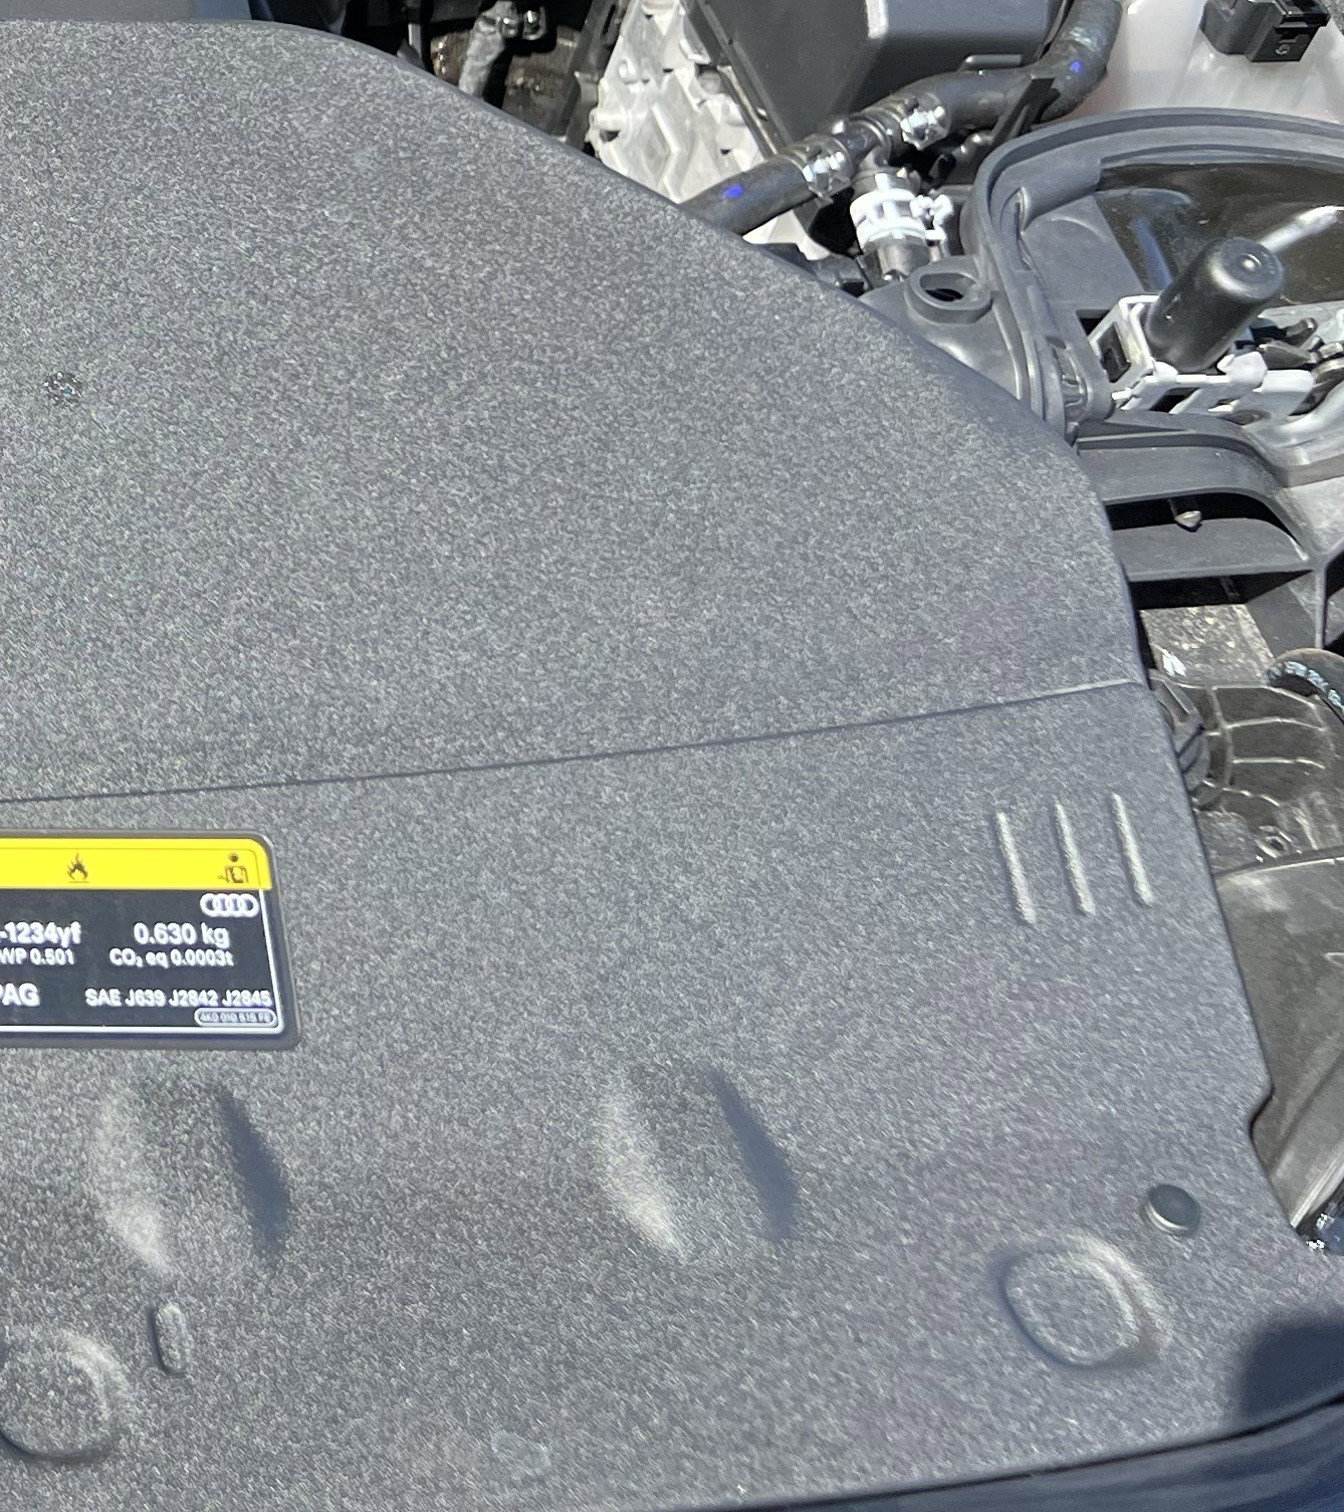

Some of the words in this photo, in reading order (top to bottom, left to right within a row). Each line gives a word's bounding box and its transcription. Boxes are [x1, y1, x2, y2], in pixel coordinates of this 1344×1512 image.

[132, 922, 198, 945] 0.630
[202, 922, 230, 949] kg
[30, 948, 75, 966] 0.501
[146, 950, 170, 968] eq
[171, 948, 234, 967] 0.0003t
[85, 990, 122, 1007] SAE
[125, 990, 165, 1007] J639
[169, 990, 218, 1007] J2842
[222, 990, 272, 1007] J2845
